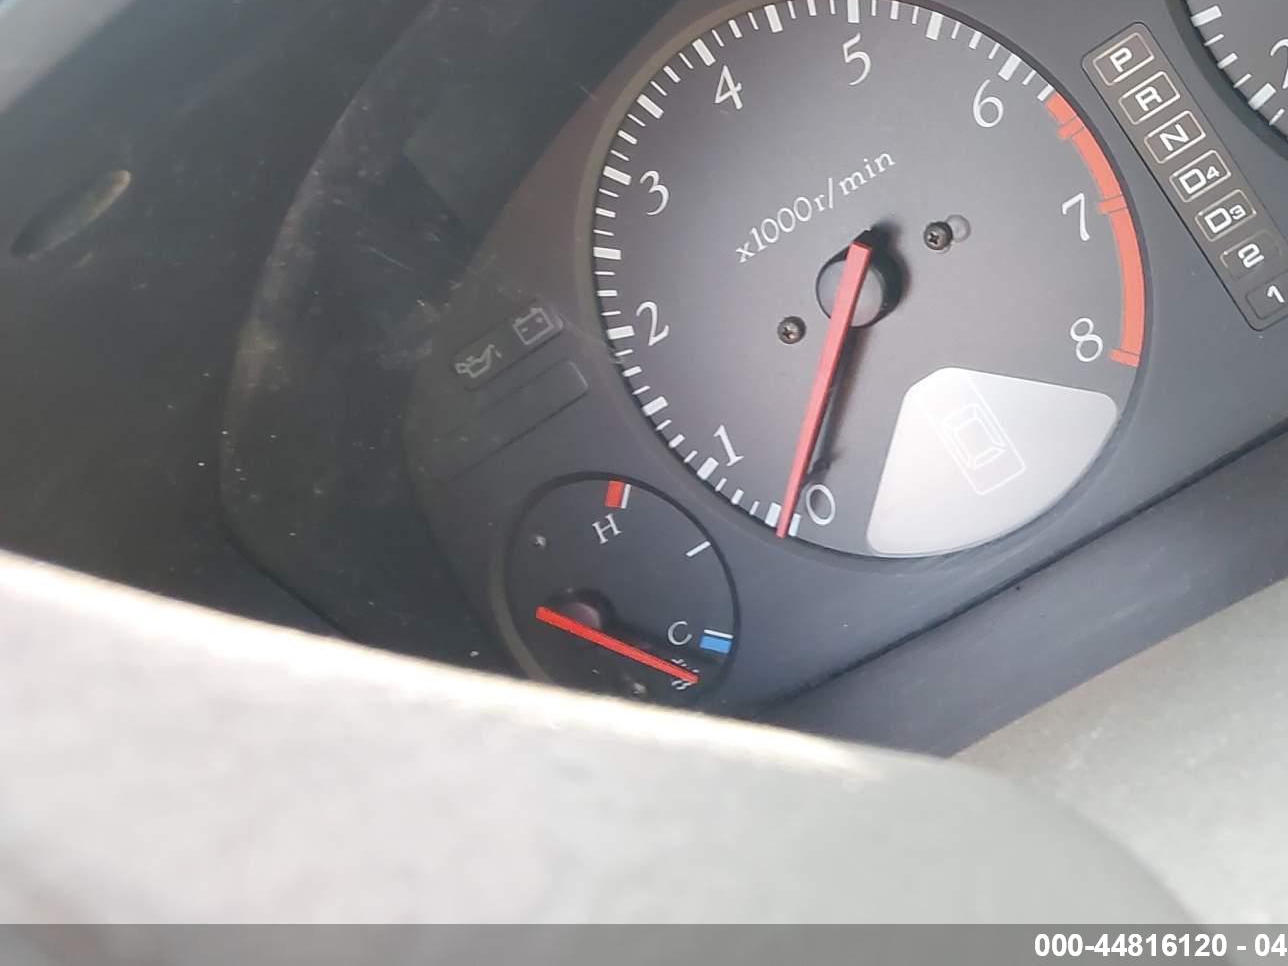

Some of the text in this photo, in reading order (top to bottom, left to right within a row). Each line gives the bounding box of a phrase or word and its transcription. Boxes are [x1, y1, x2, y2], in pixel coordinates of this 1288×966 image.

[842, 33, 871, 85] 5
[1109, 47, 1133, 72] P
[713, 65, 743, 110] 4
[973, 79, 1004, 127] 6
[1135, 86, 1162, 112] R
[1159, 124, 1188, 151] N
[639, 170, 669, 216] 3
[1179, 165, 1220, 195] D4
[734, 150, 895, 263] x1000r/min
[1061, 193, 1092, 241] 7
[1204, 204, 1246, 234] D3
[1237, 243, 1264, 268] 2
[1266, 285, 1284, 303] 1
[636, 301, 670, 346] 2
[1070, 317, 1103, 362] 8
[713, 425, 744, 466] 1
[805, 483, 836, 525] 0
[591, 514, 622, 544] H
[667, 620, 692, 645] C
